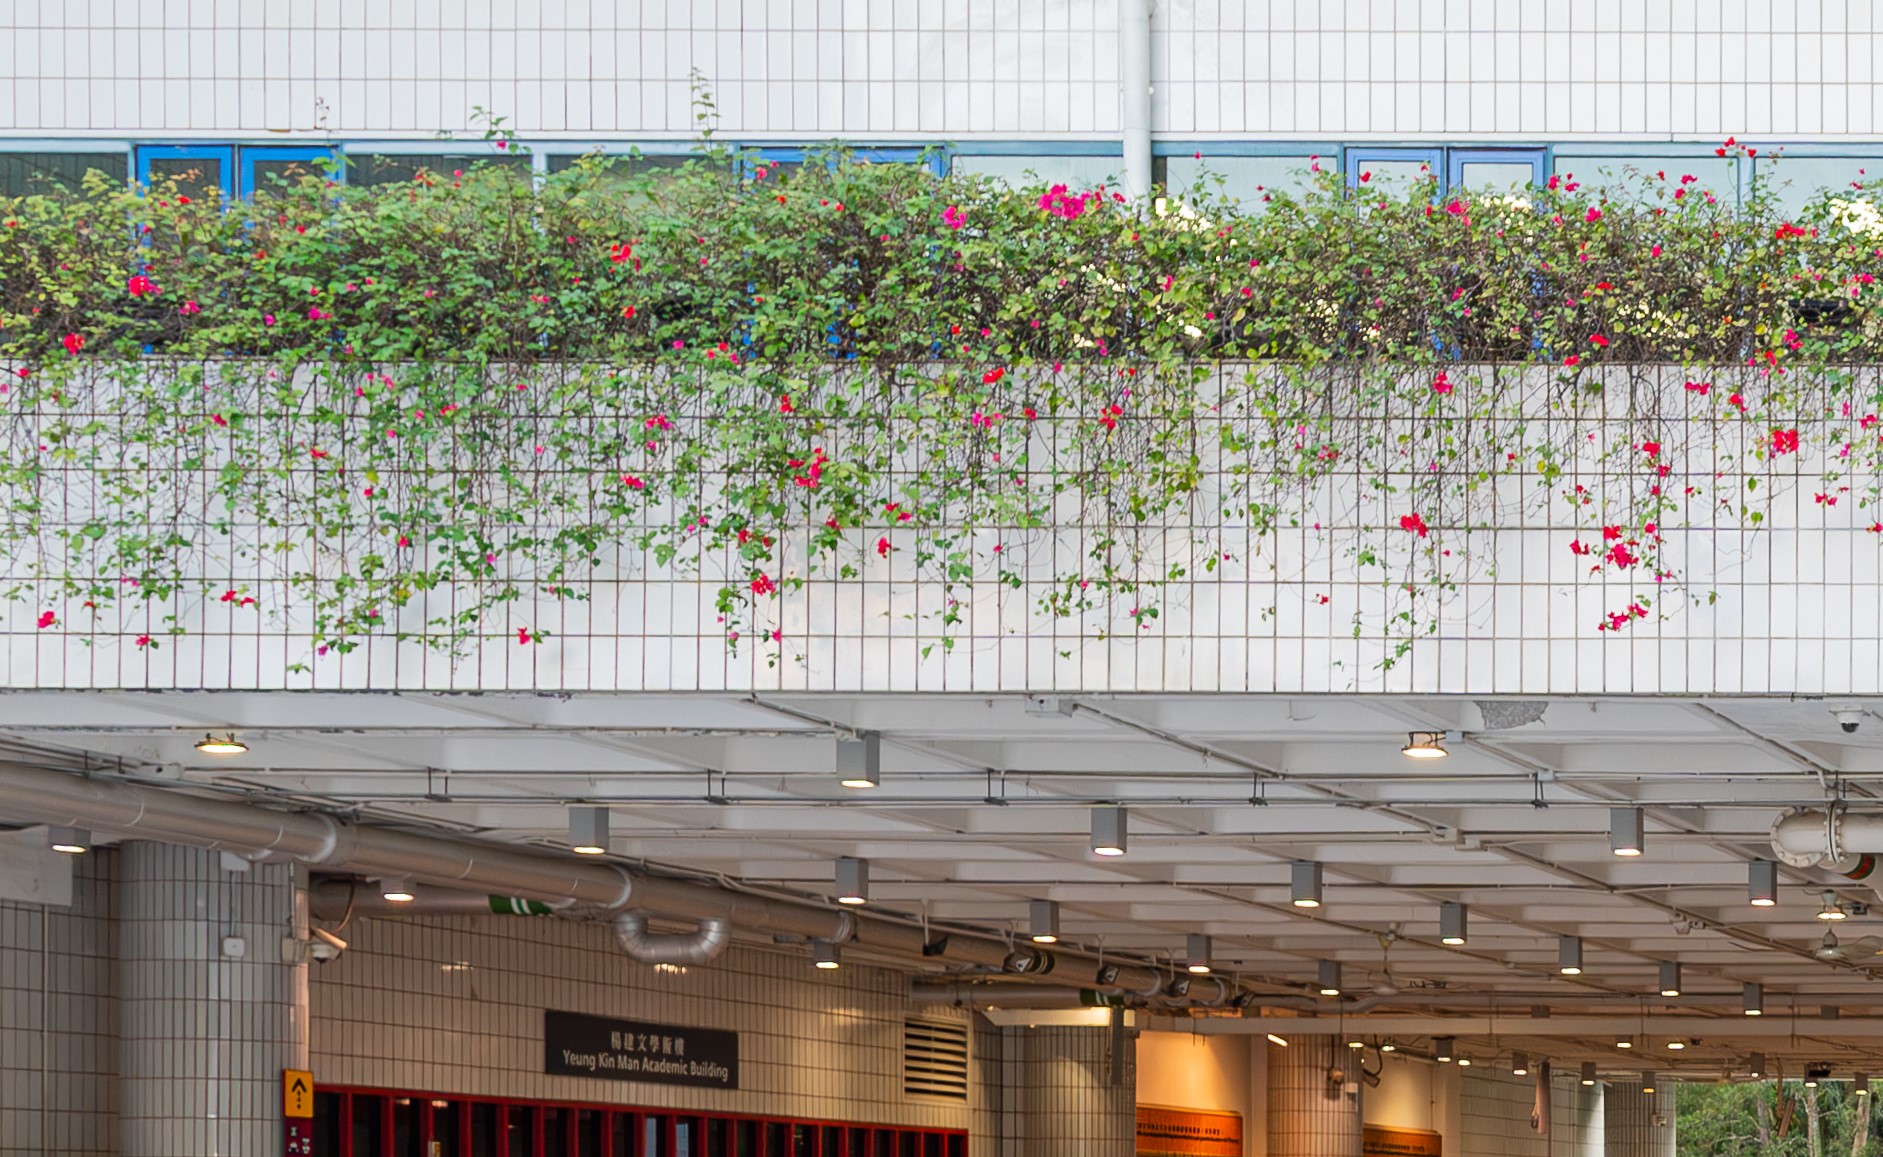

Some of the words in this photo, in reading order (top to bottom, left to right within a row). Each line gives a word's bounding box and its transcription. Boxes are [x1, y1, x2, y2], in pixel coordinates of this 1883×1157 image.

[563, 1050, 596, 1071] Yeung
[599, 1053, 616, 1067] Kin
[617, 1055, 640, 1071] Man
[642, 1058, 688, 1075] Academic
[690, 1061, 728, 1082] Building
